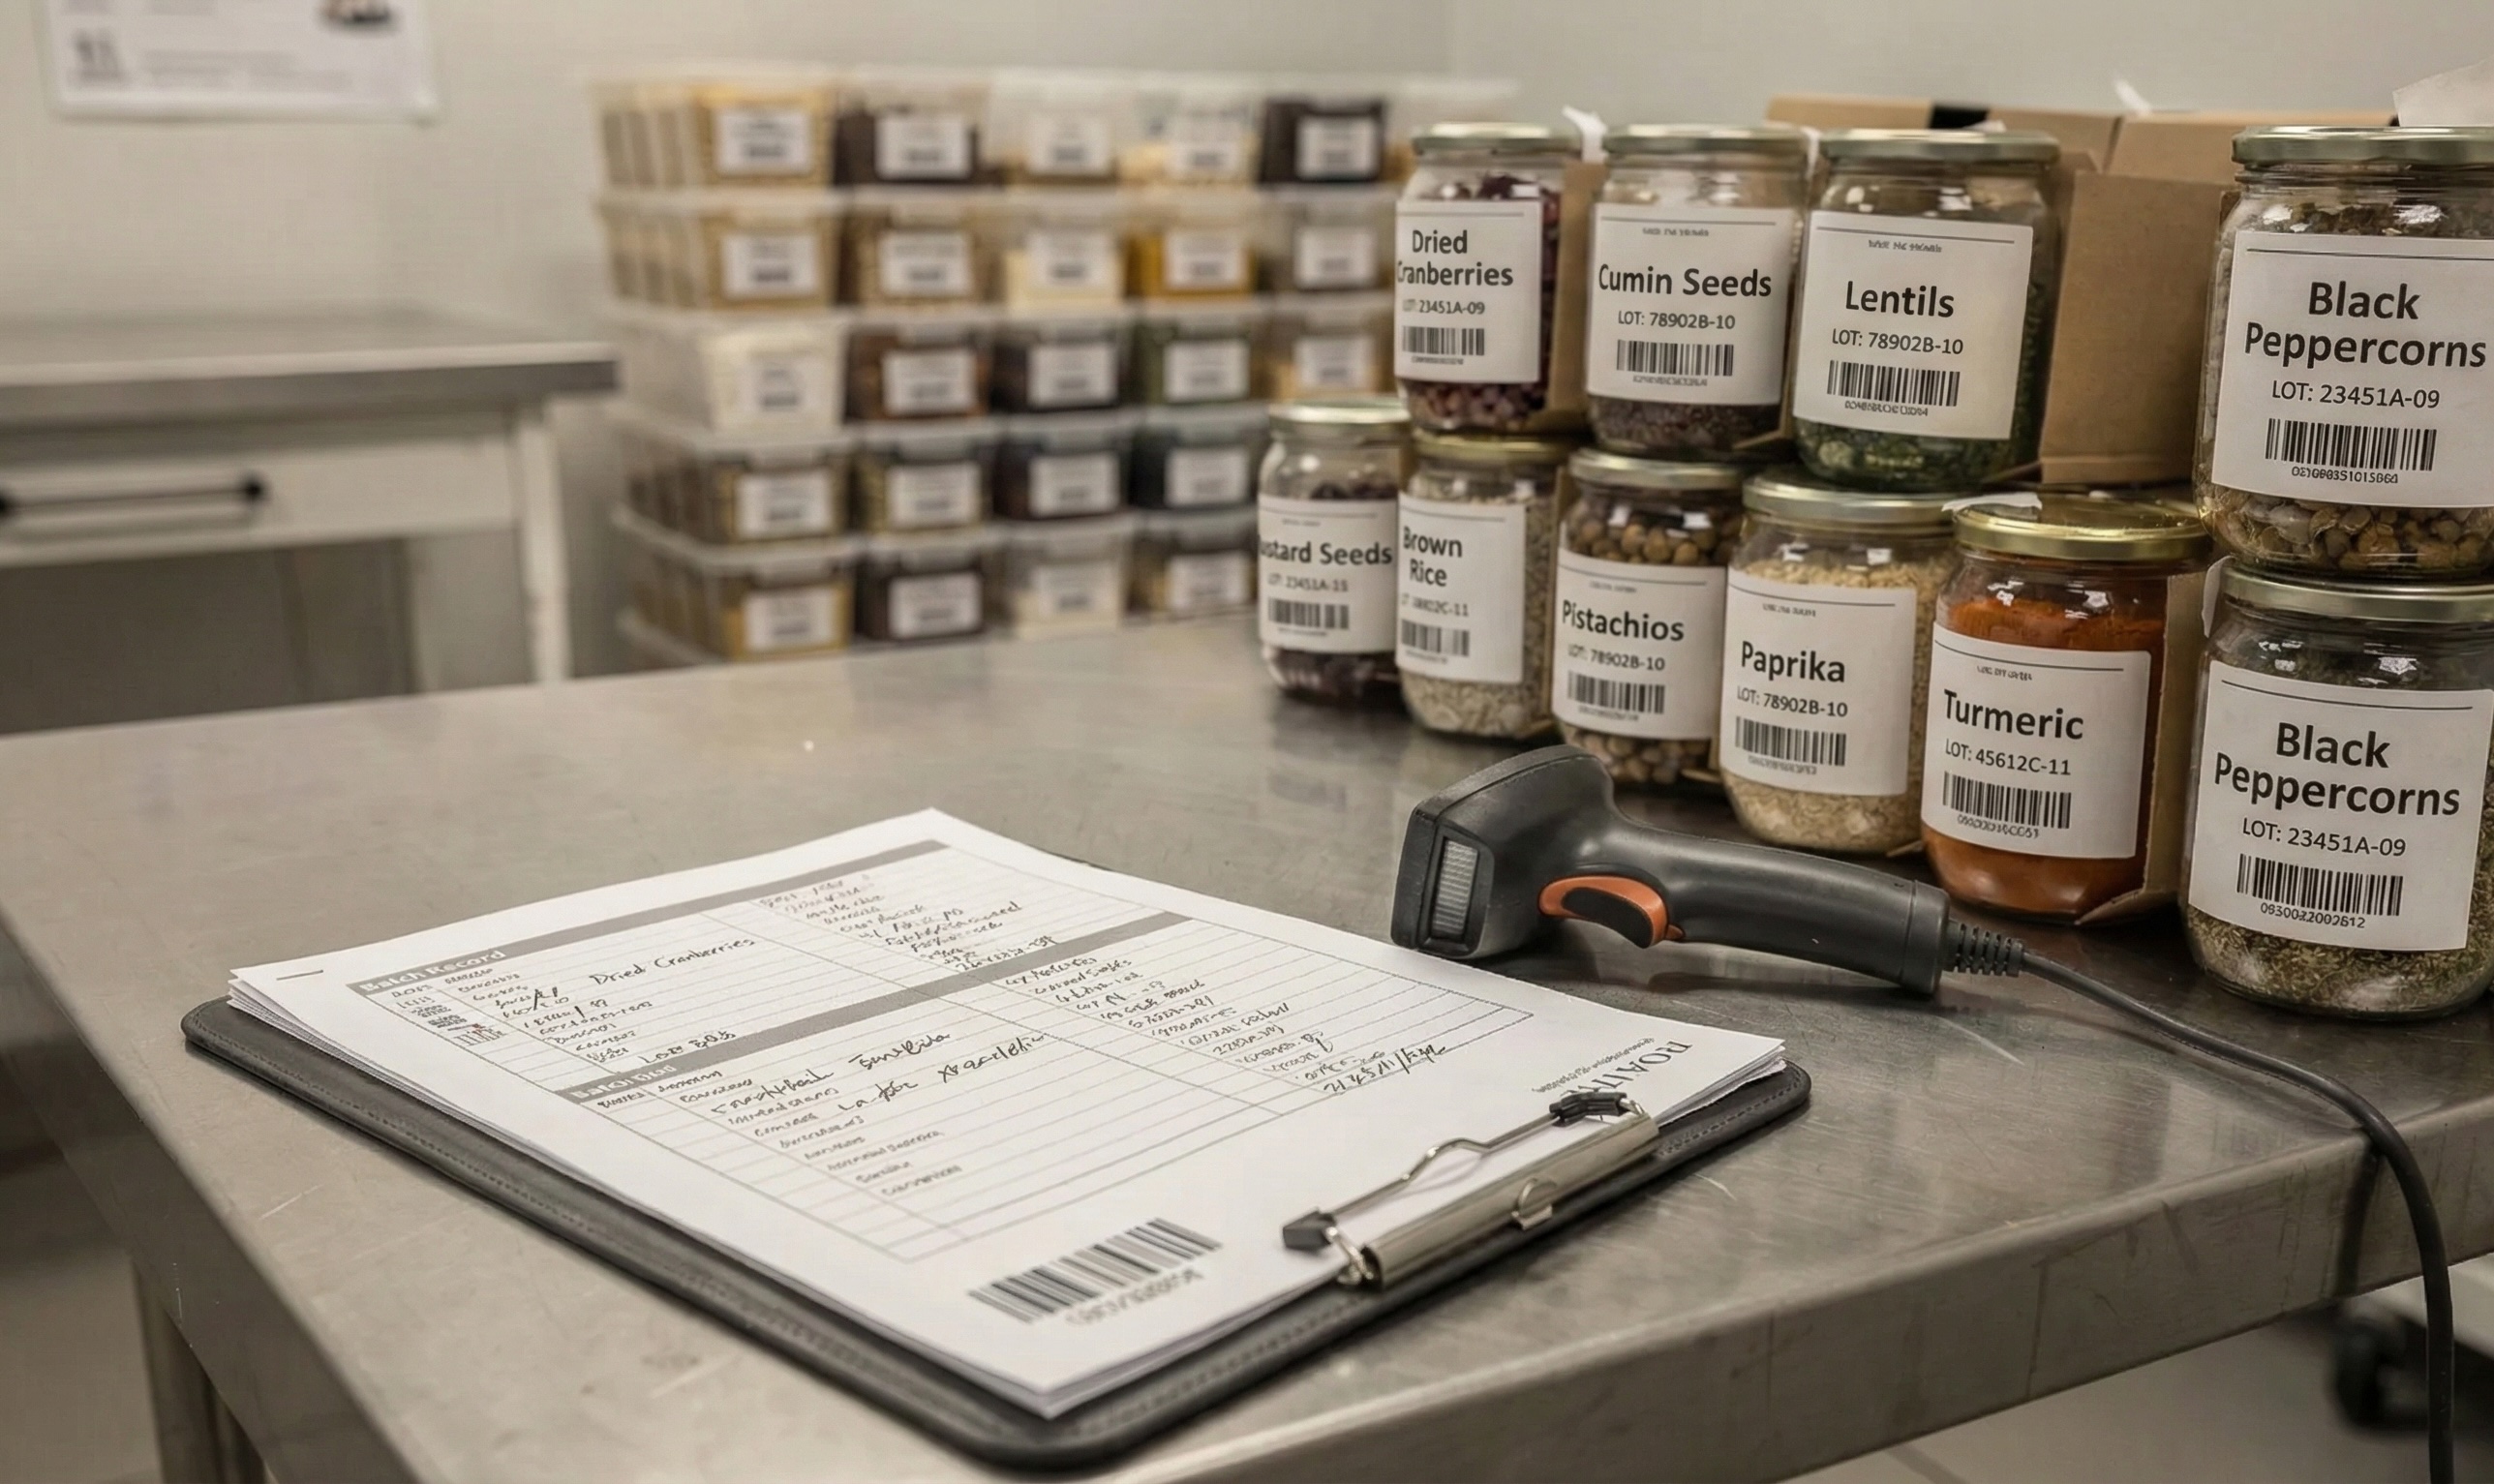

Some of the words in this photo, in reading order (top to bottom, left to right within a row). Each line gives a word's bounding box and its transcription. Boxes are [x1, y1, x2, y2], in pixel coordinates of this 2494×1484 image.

[1412, 229, 1468, 255] Dried
[1598, 263, 1673, 295] Cumin
[1682, 267, 1772, 297] Seeds
[1845, 280, 1955, 318] Lentils
[1418, 299, 1486, 316] 23451A-09
[2308, 280, 2421, 320] Black
[1617, 310, 1645, 326] LOT:
[1649, 312, 1736, 330] 78902B-10
[1832, 327, 1863, 347] LOT:
[1868, 331, 1964, 355] 78902B-10
[2244, 321, 2487, 369] Peppercorns
[2271, 379, 2314, 403] LOT:
[2319, 383, 2441, 409] 23451A-09
[1320, 541, 1393, 566] Seeds
[1402, 526, 1463, 559] Brown
[1409, 558, 1448, 587] Rice
[1562, 599, 1685, 642] Pistachios
[1590, 648, 1666, 672] 78902B-10
[1741, 640, 1845, 682] Paprika
[1736, 685, 1760, 706] LOT:
[1762, 692, 1848, 718] 78902B-10
[1943, 688, 2084, 741] Turmeric
[1945, 738, 1972, 762] LOT:
[1975, 748, 2072, 776] 45612C-11
[2276, 721, 2391, 770] Black
[2214, 751, 2460, 816] Peppercorns
[2242, 817, 2282, 842] LOT:
[2287, 827, 2407, 857] 23451A-09
[359, 966, 427, 993] Batch
[429, 950, 507, 977] Record
[588, 963, 647, 985] Dried
[653, 938, 756, 969] Cranberries
